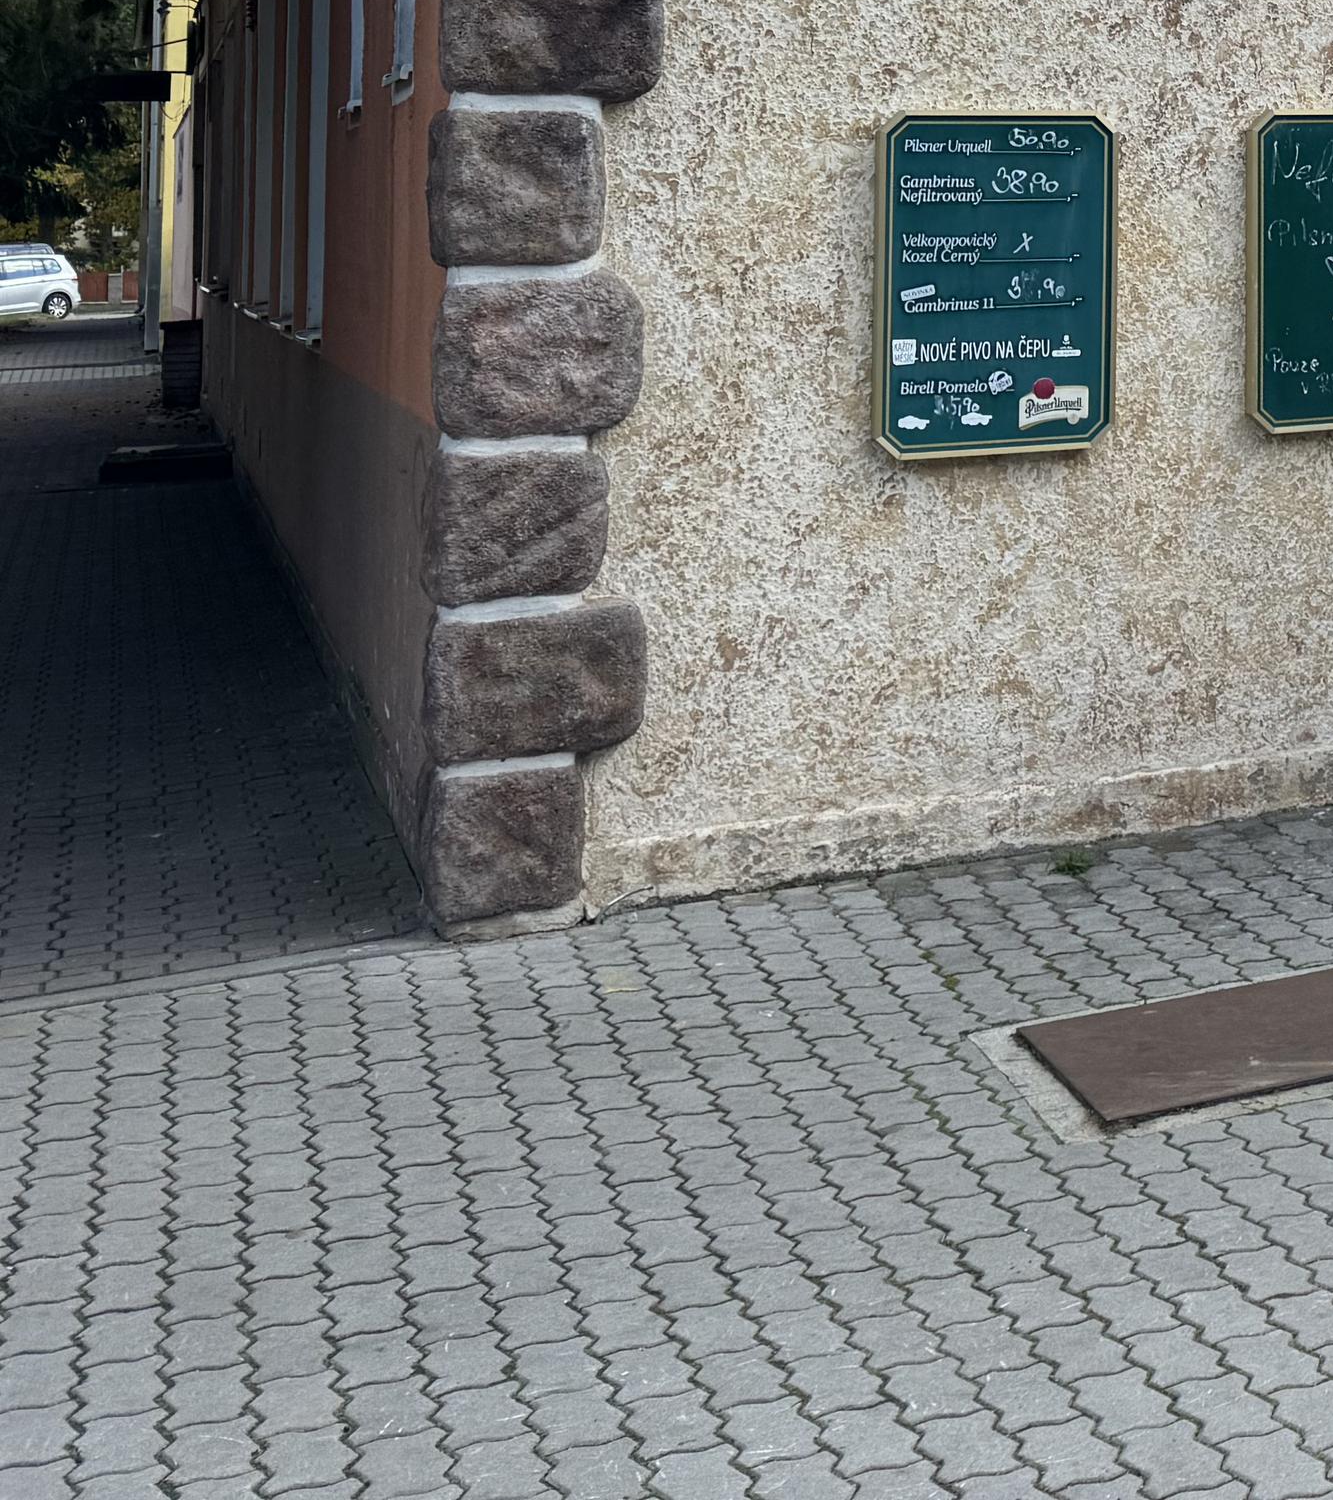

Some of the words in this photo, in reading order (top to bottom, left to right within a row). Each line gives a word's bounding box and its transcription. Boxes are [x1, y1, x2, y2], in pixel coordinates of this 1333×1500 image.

[904, 139, 947, 153] Pilsner
[948, 139, 993, 156] Urquell
[900, 175, 975, 189] Gambrinus
[991, 166, 1059, 194] 38,90
[900, 188, 983, 205] Nefiltrovaný
[902, 233, 997, 249] Velkopopovický
[902, 249, 938, 263] Kozel
[941, 248, 981, 265] Černý
[904, 298, 980, 313] Gambrinus
[982, 297, 995, 310] 11
[920, 337, 956, 363] NOVÉ
[960, 341, 991, 361] PIVO
[995, 340, 1014, 359] NA
[1018, 334, 1051, 359] ČEPU
[900, 381, 935, 396] Birell
[938, 379, 988, 395] Pomelo
[1025, 399, 1054, 419] Pilsner
[1053, 396, 1082, 412] Urquell
